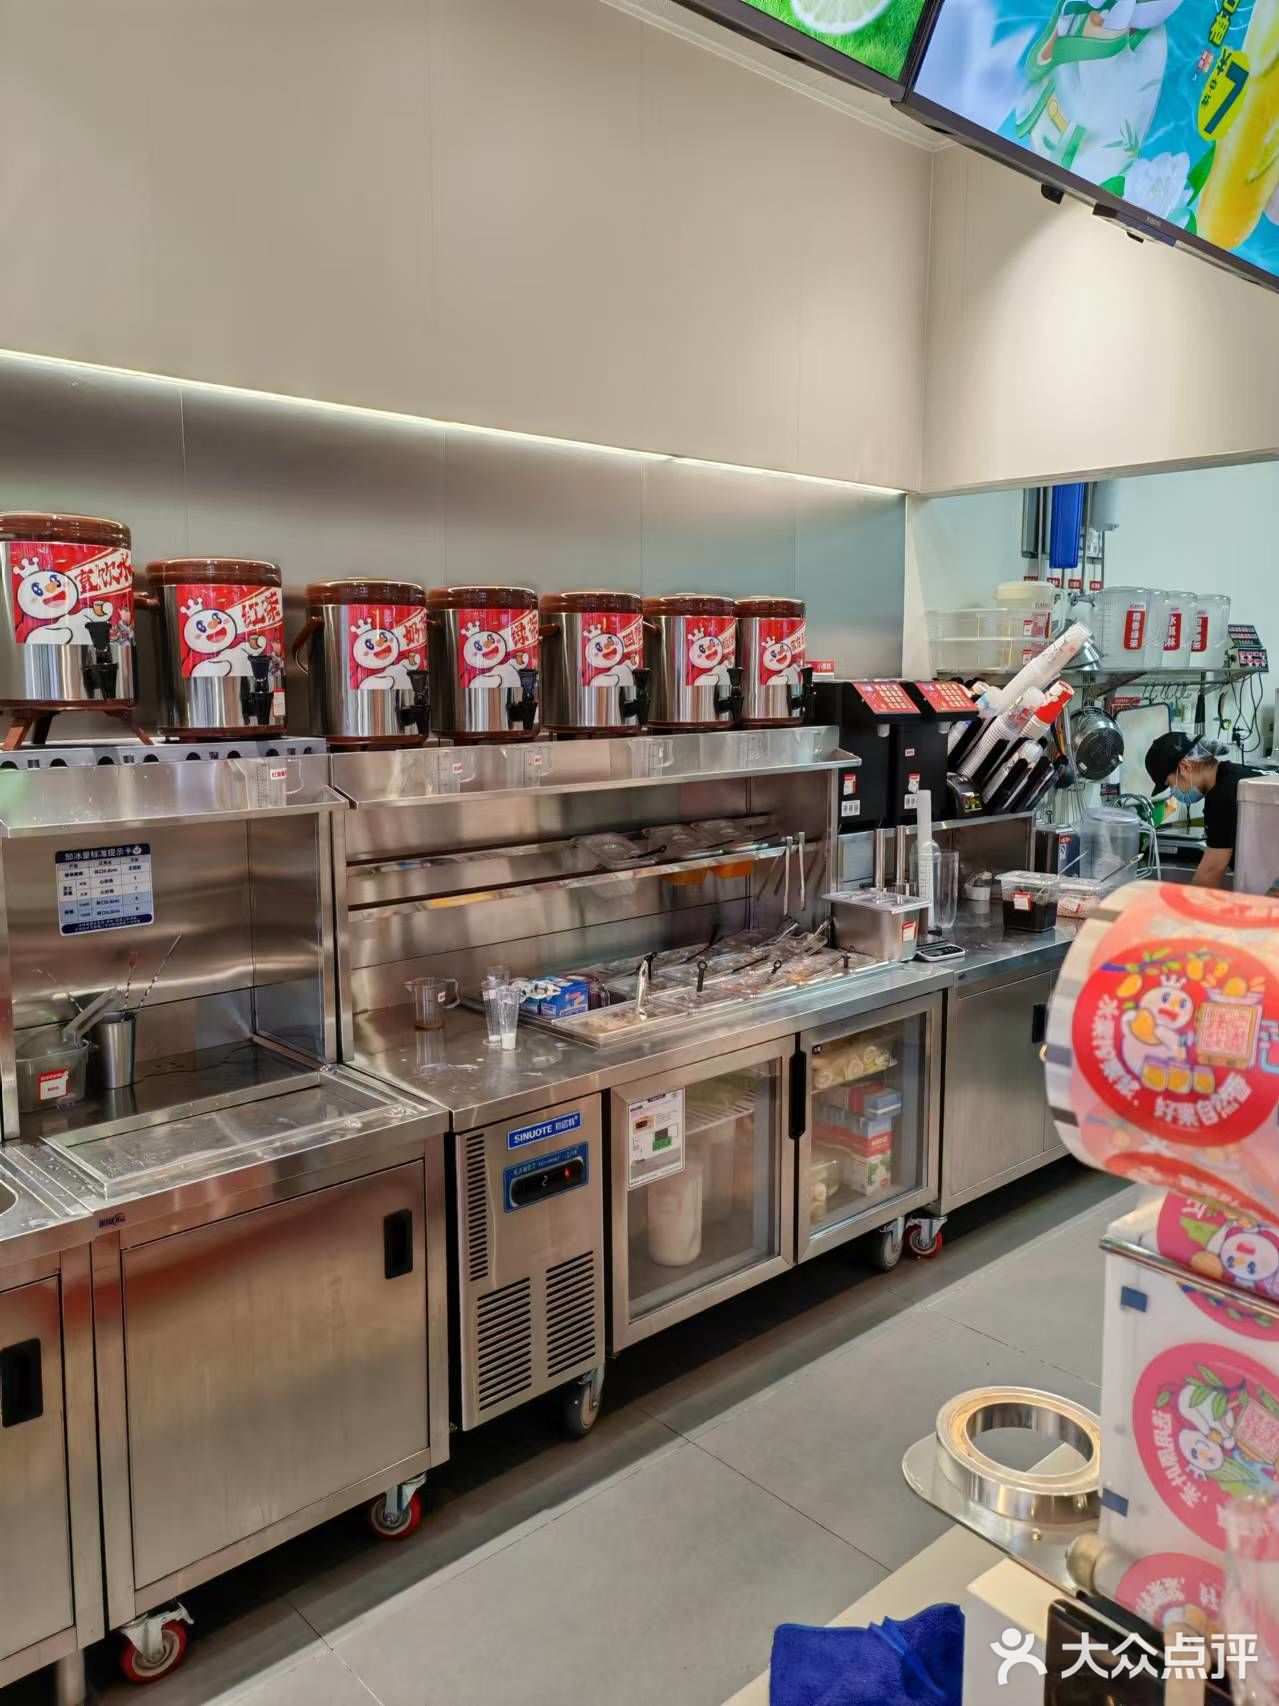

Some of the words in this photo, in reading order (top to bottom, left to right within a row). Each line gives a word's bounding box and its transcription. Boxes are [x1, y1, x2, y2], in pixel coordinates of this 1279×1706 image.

[74, 551, 134, 595] 直饮水
[242, 591, 281, 629] 红茶
[513, 1124, 553, 1144] SINUOTE
